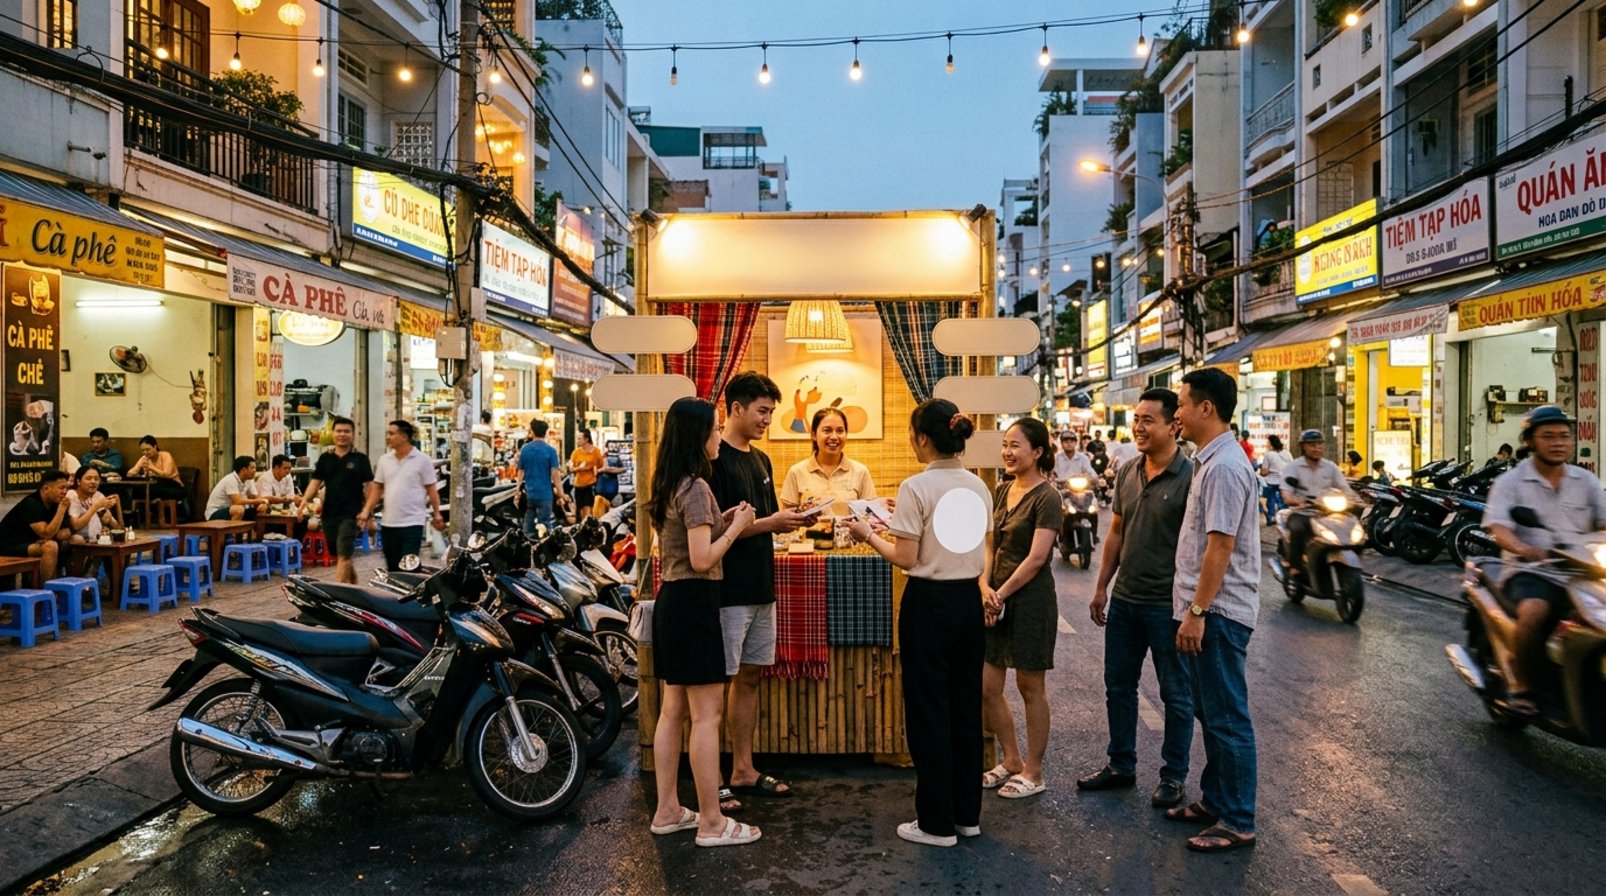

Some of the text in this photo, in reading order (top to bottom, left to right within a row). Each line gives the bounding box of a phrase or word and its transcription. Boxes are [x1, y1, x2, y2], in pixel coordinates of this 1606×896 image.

[1517, 160, 1576, 216] QUÁN
[31, 218, 67, 257] Cà
[70, 231, 118, 267] phê
[1385, 216, 1417, 251] TIỆM
[1418, 206, 1446, 241] TẠP
[1450, 188, 1482, 229] HÓA
[484, 237, 510, 274] TIỆM
[511, 252, 530, 282] TẠP
[262, 272, 300, 307] CÀ
[303, 285, 348, 317] PHÊ
[7, 319, 26, 349] CÀ
